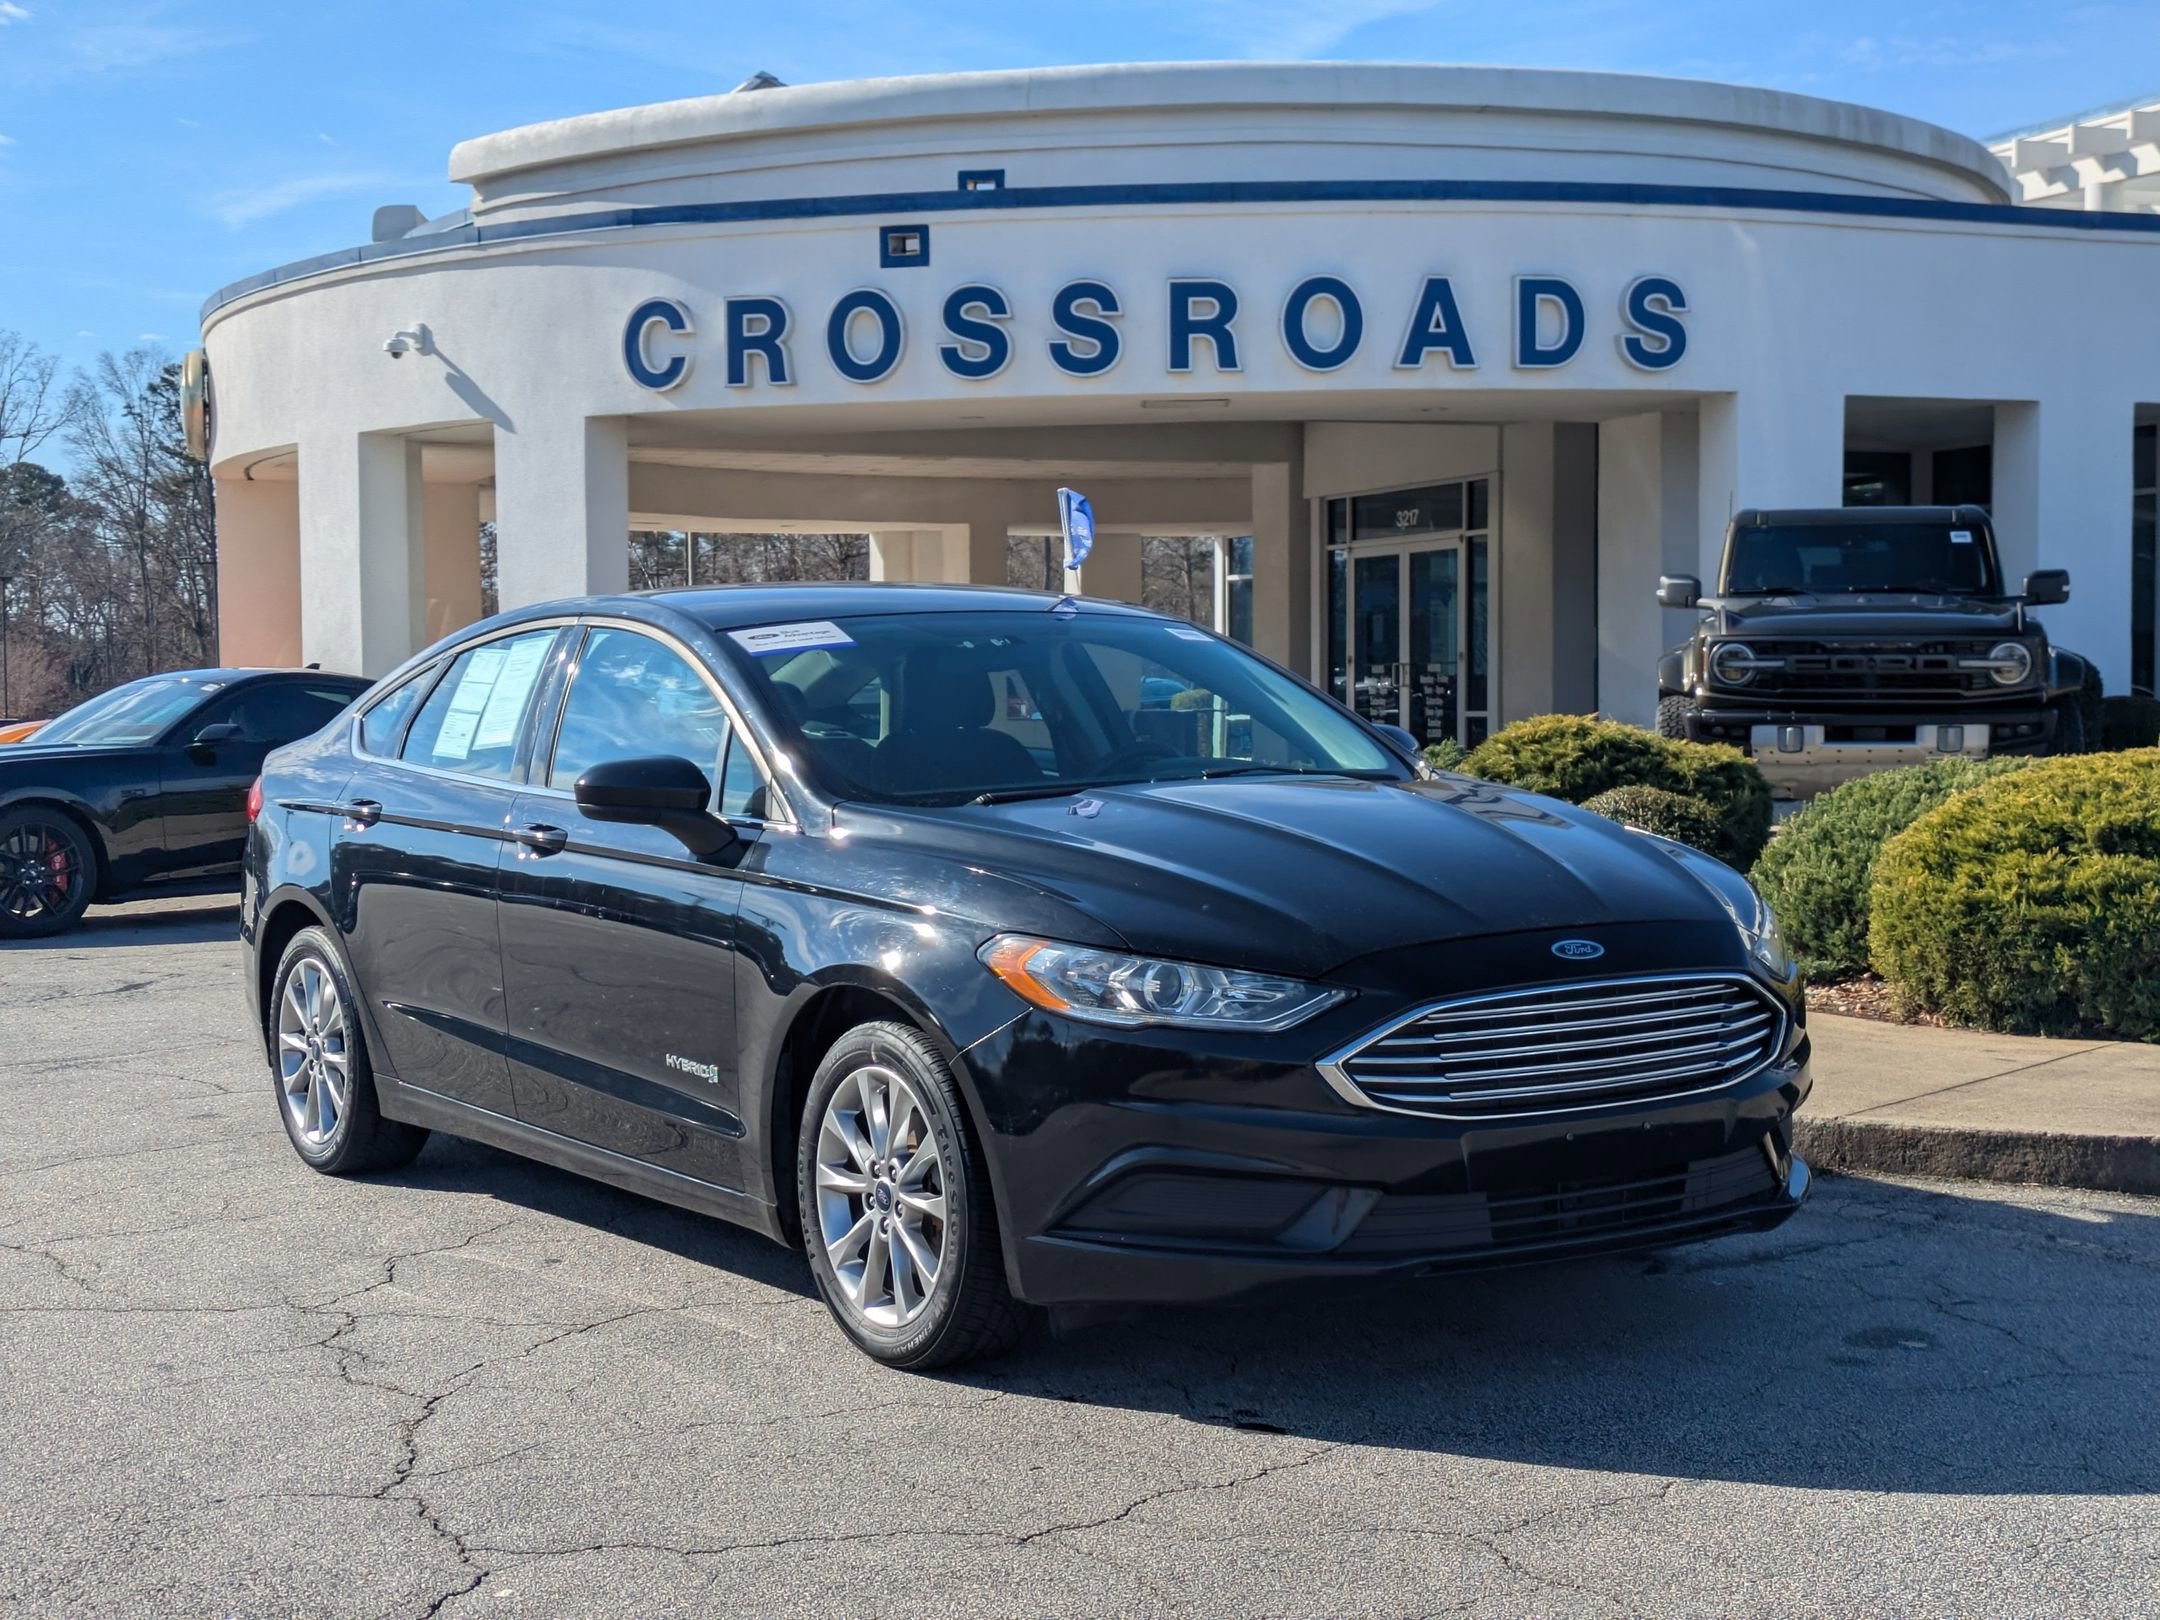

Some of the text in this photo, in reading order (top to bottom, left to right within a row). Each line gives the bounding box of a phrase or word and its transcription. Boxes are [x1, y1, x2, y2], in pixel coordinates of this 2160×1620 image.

[623, 274, 1690, 392] CROSSROADS
[1564, 943, 1593, 954] Ford
[665, 1053, 711, 1079] HYBRID
